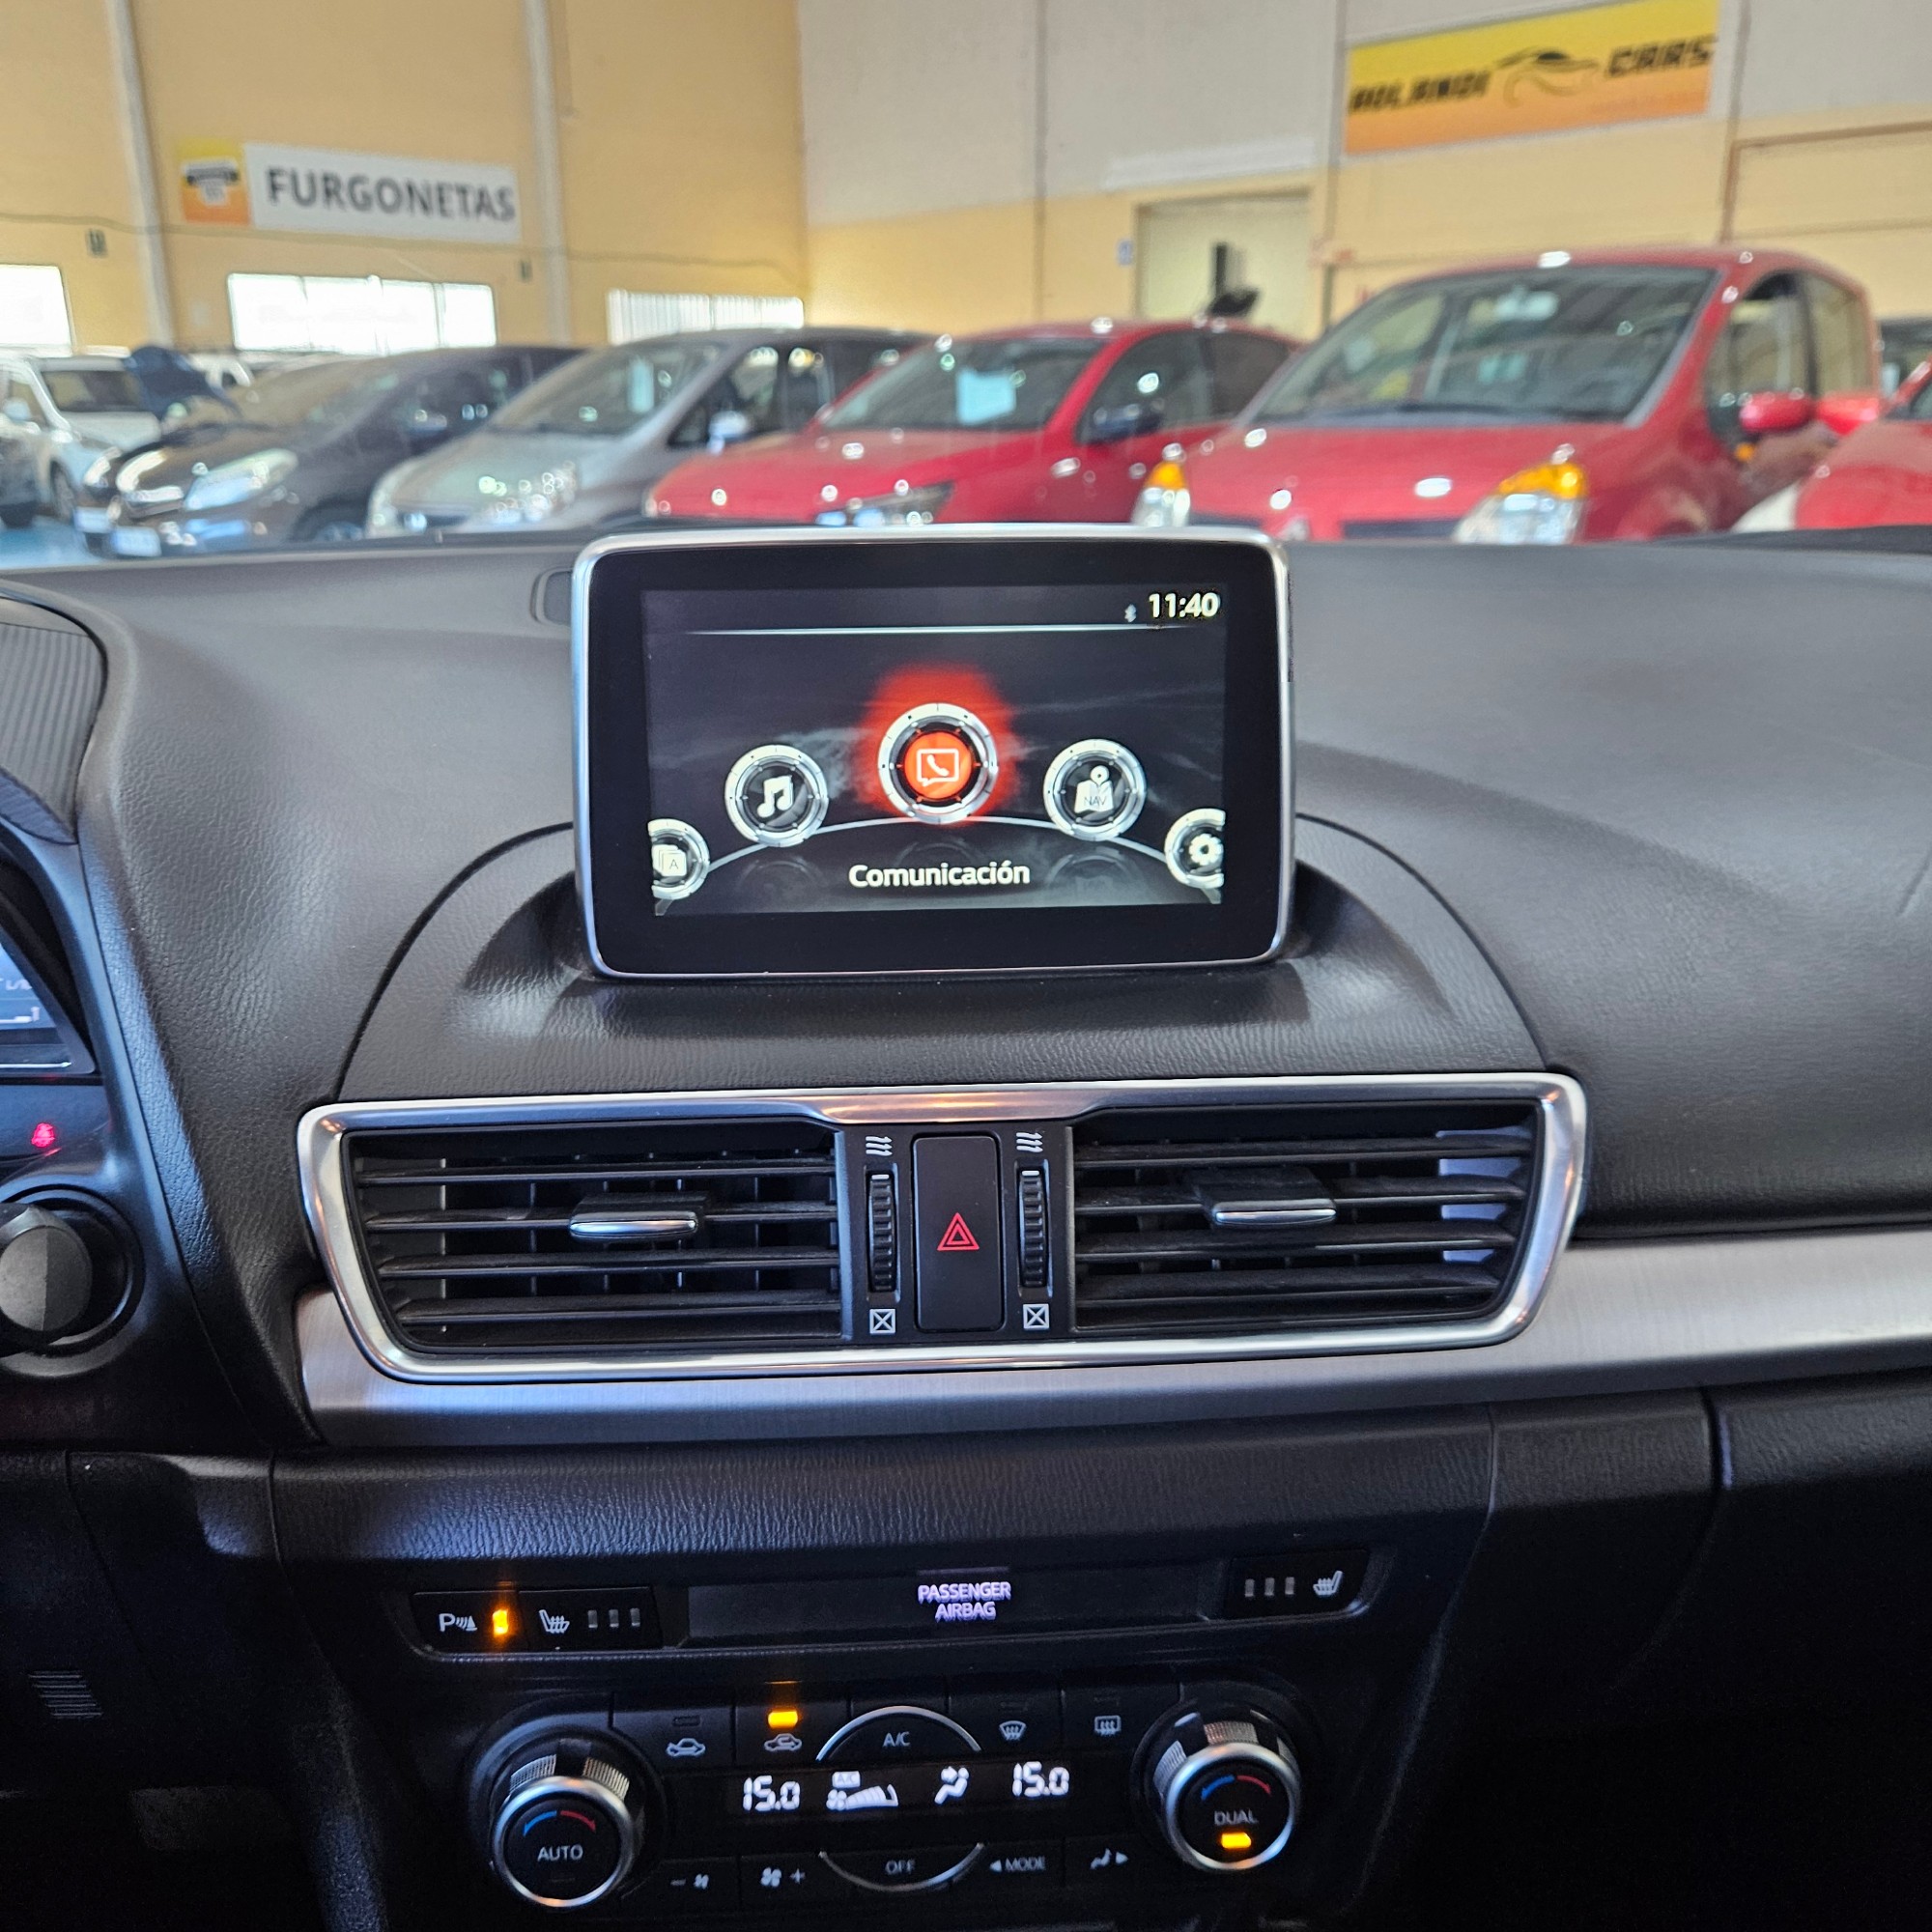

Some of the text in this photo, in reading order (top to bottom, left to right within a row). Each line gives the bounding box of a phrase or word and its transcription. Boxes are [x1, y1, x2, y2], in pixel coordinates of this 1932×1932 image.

[267, 165, 517, 222] FURGONETAS
[1149, 592, 1220, 618] 11:40
[1083, 795, 1108, 807] NAV
[848, 859, 1031, 887] Comunicación
[918, 1581, 1011, 1604] PASSENGER
[935, 1601, 996, 1622] AIRBAG
[882, 1731, 911, 1747] A/C
[1011, 1760, 1069, 1798] 15.0
[743, 1775, 801, 1812] 15.0
[1213, 1808, 1259, 1826] DUAL
[537, 1844, 583, 1862] AUTO
[885, 1860, 916, 1875] OFF
[1005, 1856, 1045, 1872] MODE
